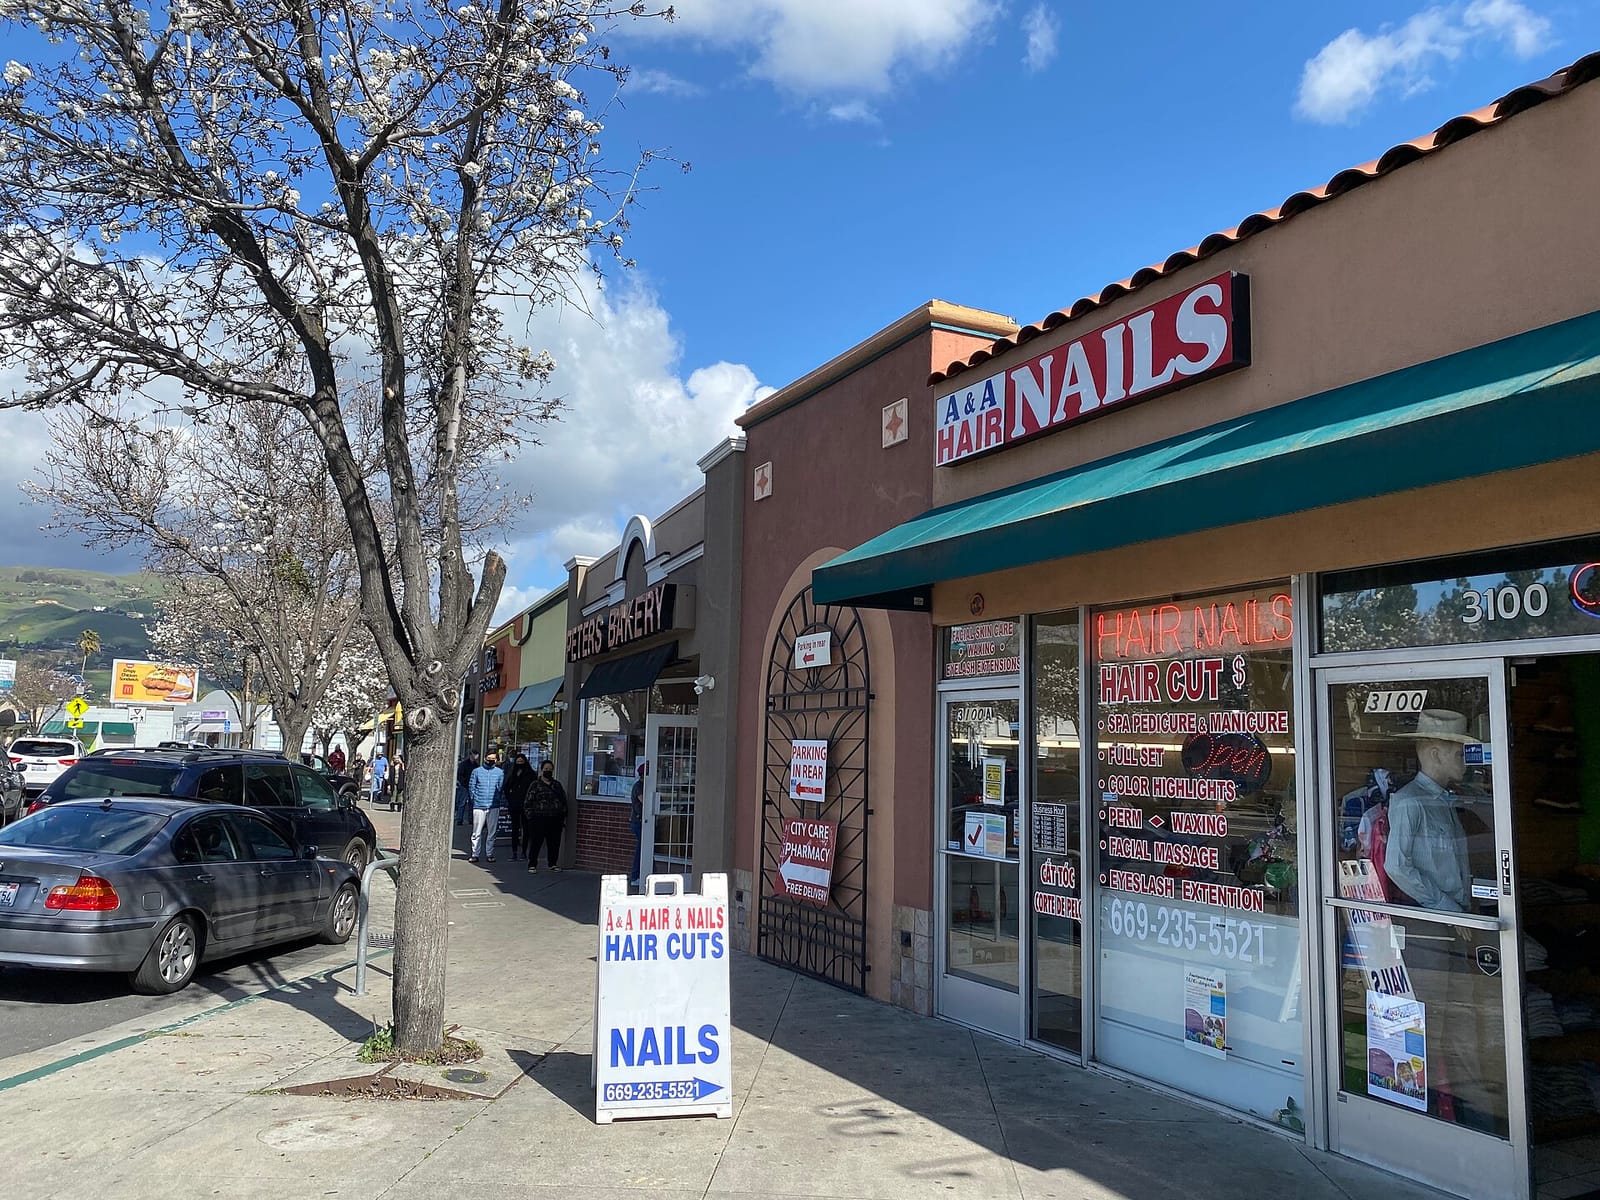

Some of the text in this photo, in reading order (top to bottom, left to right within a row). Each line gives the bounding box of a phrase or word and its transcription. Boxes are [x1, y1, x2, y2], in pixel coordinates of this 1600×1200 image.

[1010, 283, 1228, 438] NAILS
[944, 379, 997, 425] A & A
[937, 407, 1002, 464] HAIR
[1461, 582, 1550, 624] 3100
[567, 583, 665, 661] PETERS BAKERY
[952, 622, 1014, 642] FACIAL SKIN CARE
[1098, 594, 1294, 659] HAIR NAILS
[797, 640, 826, 652] Parking in rear
[967, 641, 995, 657] WAXING
[946, 656, 1021, 677] EYELASH EXTENSIONS
[1100, 655, 1245, 705] HAIR CUT $
[957, 707, 993, 722] 3100A
[1367, 692, 1423, 712] 3100
[1108, 710, 1288, 734] SPA PEDICURE & MANICURE
[792, 745, 827, 760] PARKING
[1108, 746, 1164, 767] FULL SET
[793, 764, 824, 780] IN REAR
[1108, 775, 1235, 801] COLOR HIGHLIGHTS
[790, 821, 807, 837] CITY
[808, 823, 829, 840] CARE
[1109, 807, 1227, 837] PERM WAXING
[784, 842, 830, 863] PHARMACY
[1109, 836, 1219, 869] FACIAL MASSAGE
[1502, 853, 1511, 885] PULL
[786, 882, 827, 902] FREE DELIVERY
[1034, 891, 1056, 915] CORTE
[1056, 895, 1065, 917] DE
[1109, 870, 1264, 913] EYESLASH EXTENTION
[606, 907, 724, 931] A & A HAIR & NAILS
[1111, 898, 1264, 965] 669-235-5521
[605, 932, 724, 961] HAIR CUTS
[610, 1024, 720, 1068] NAILS
[606, 1081, 699, 1100] 669-235-5521
